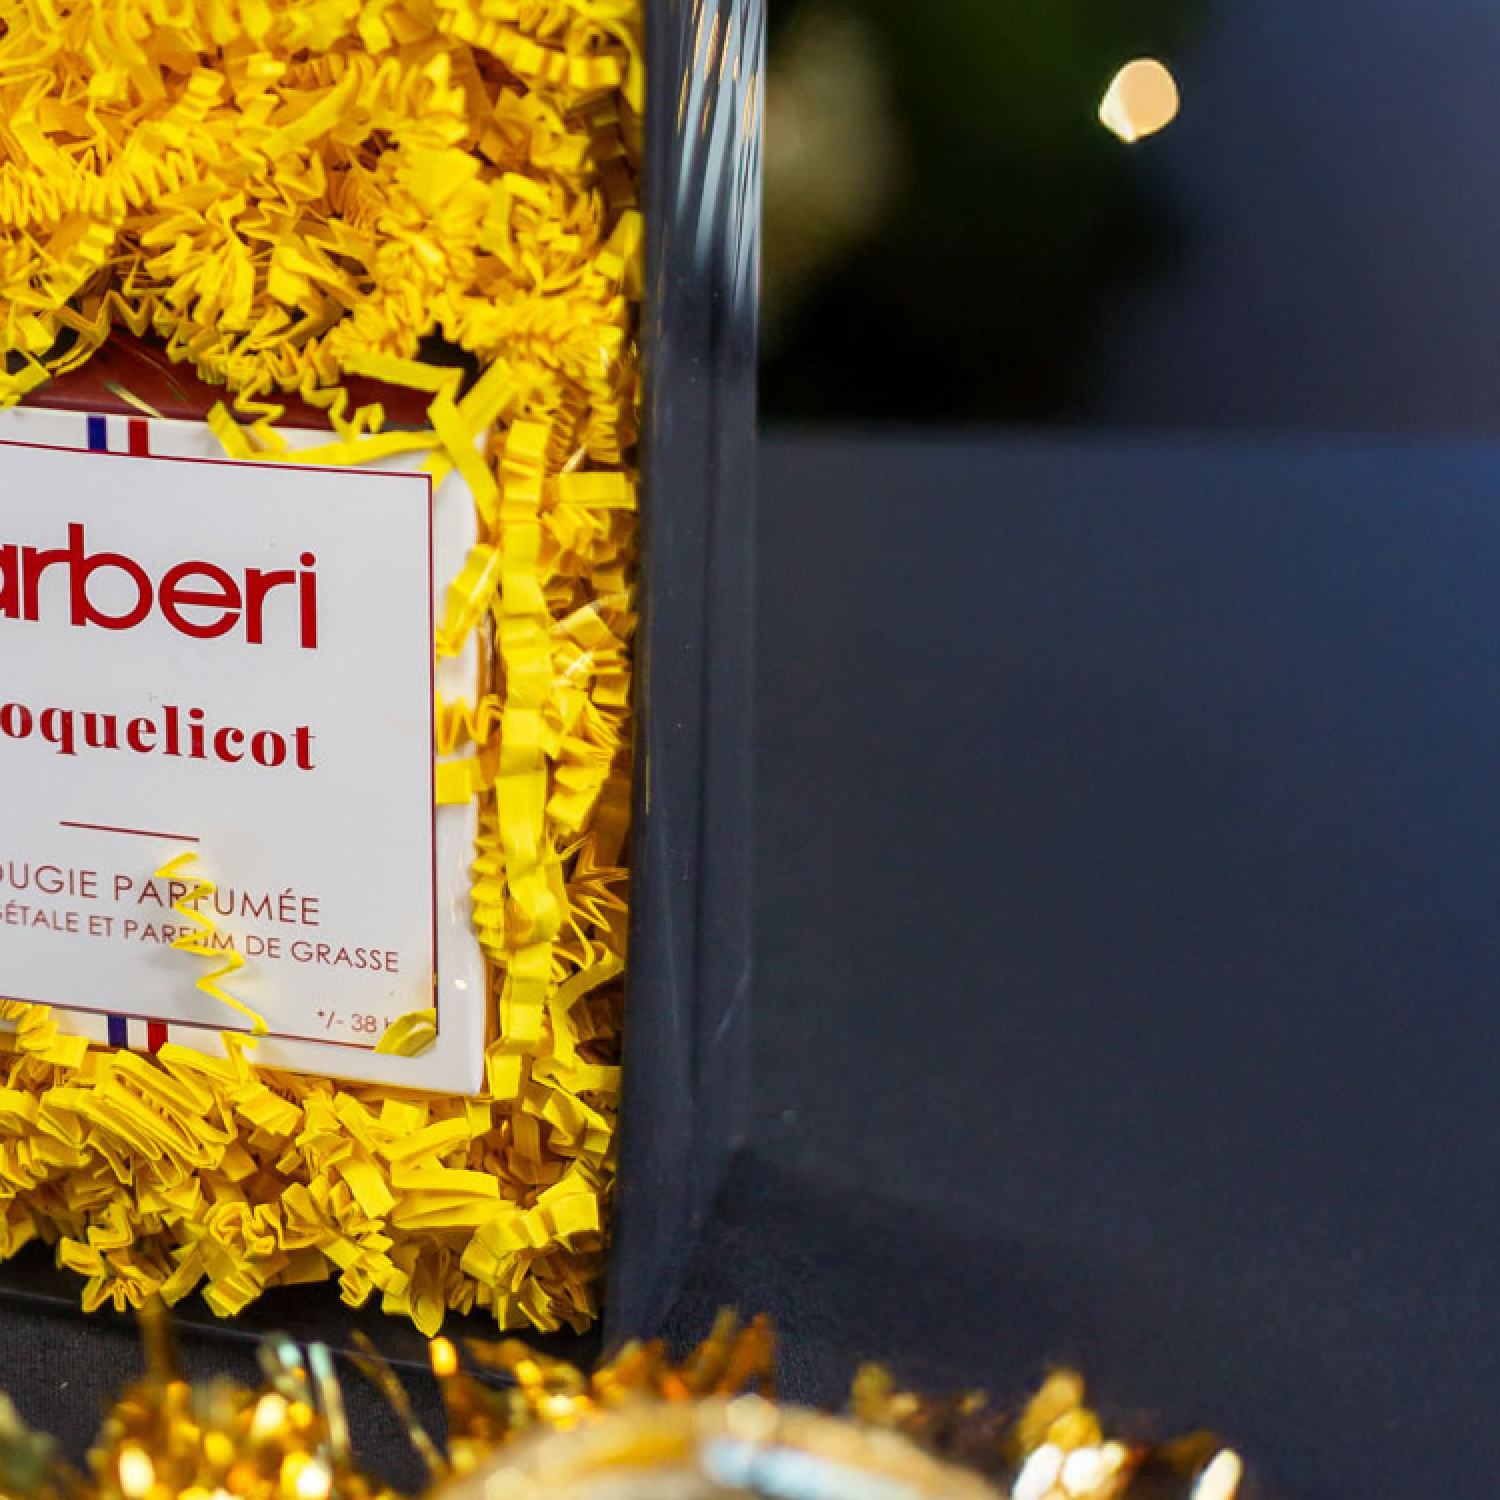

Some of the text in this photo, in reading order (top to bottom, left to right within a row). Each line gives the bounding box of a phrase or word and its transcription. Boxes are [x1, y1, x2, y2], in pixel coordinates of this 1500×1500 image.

[88, 914, 115, 938] ET
[245, 933, 281, 959] DE
[290, 938, 400, 974] GRASSE
[350, 1011, 378, 1034] 38
